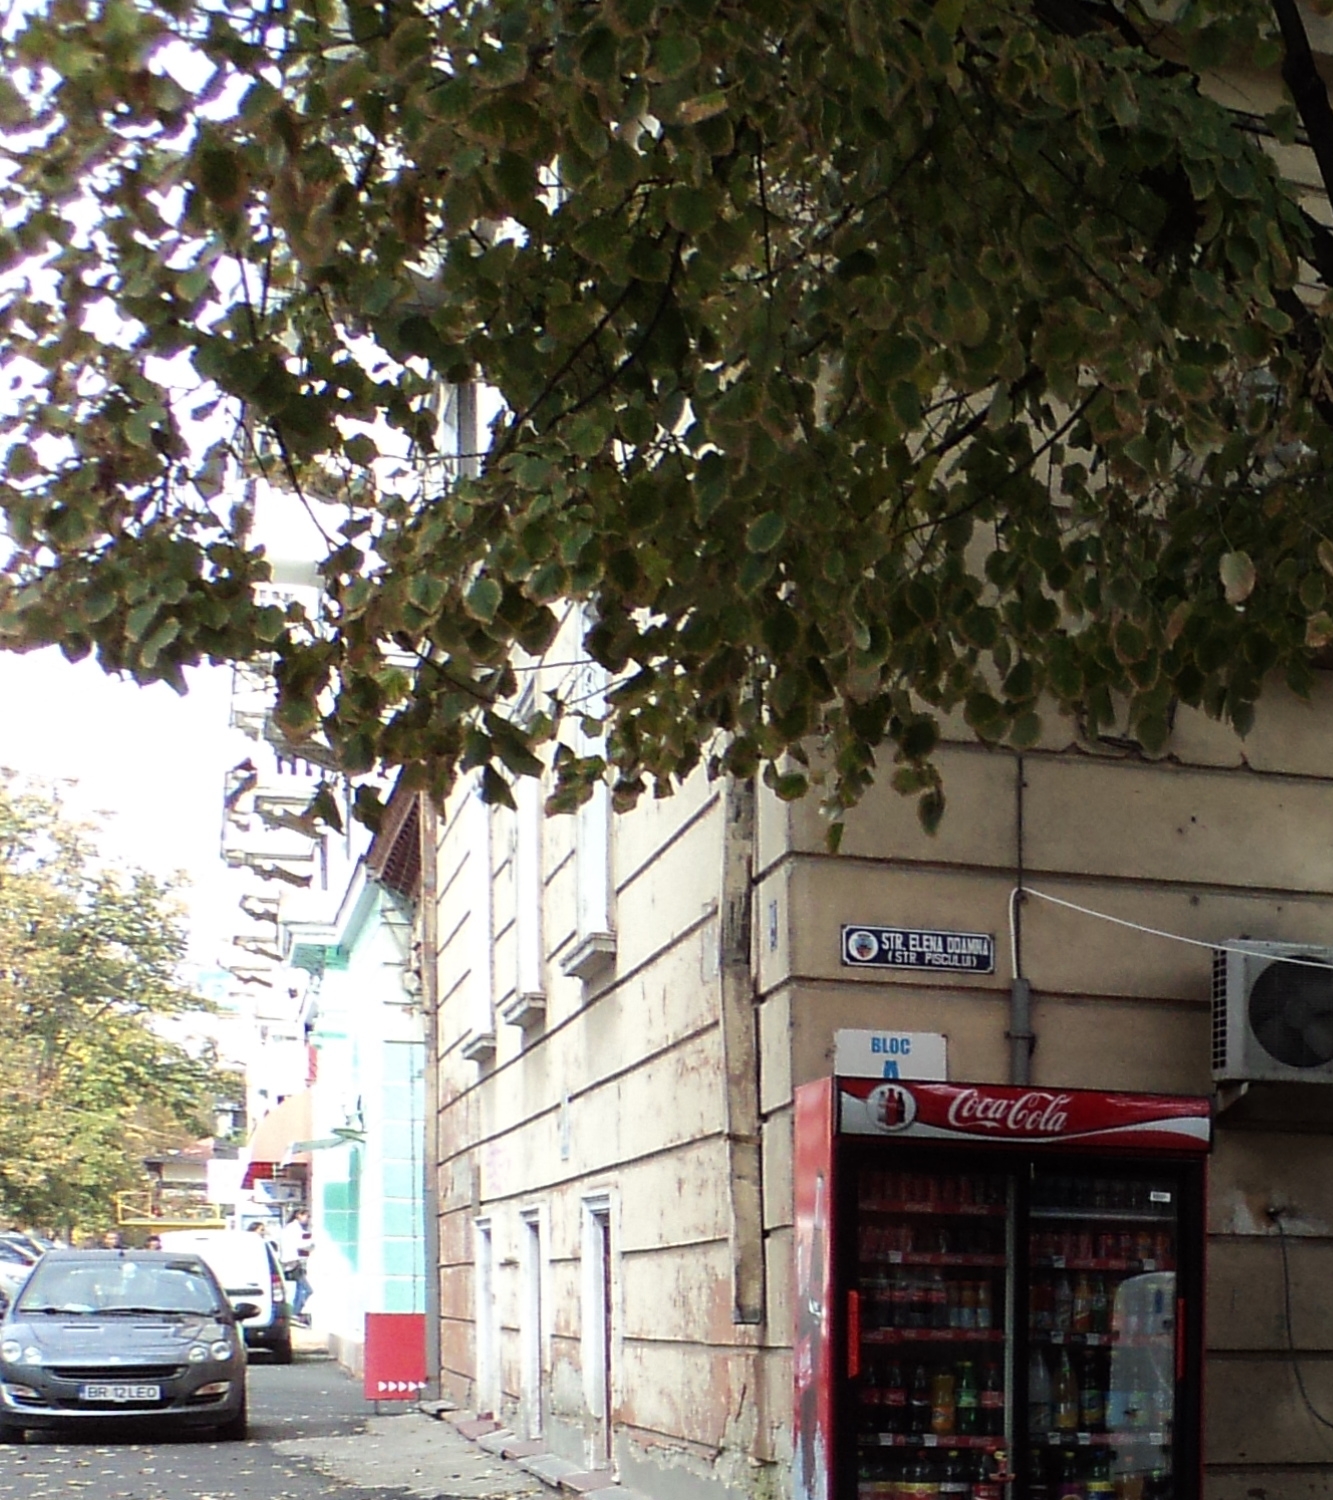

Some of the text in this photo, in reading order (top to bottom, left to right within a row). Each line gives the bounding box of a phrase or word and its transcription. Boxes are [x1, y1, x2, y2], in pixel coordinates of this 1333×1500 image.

[881, 932, 989, 956] STR. ELENA DOAMNA
[871, 1037, 911, 1056] BLOC
[947, 1088, 1073, 1132] Coca-Cola
[88, 1386, 107, 1398] BR
